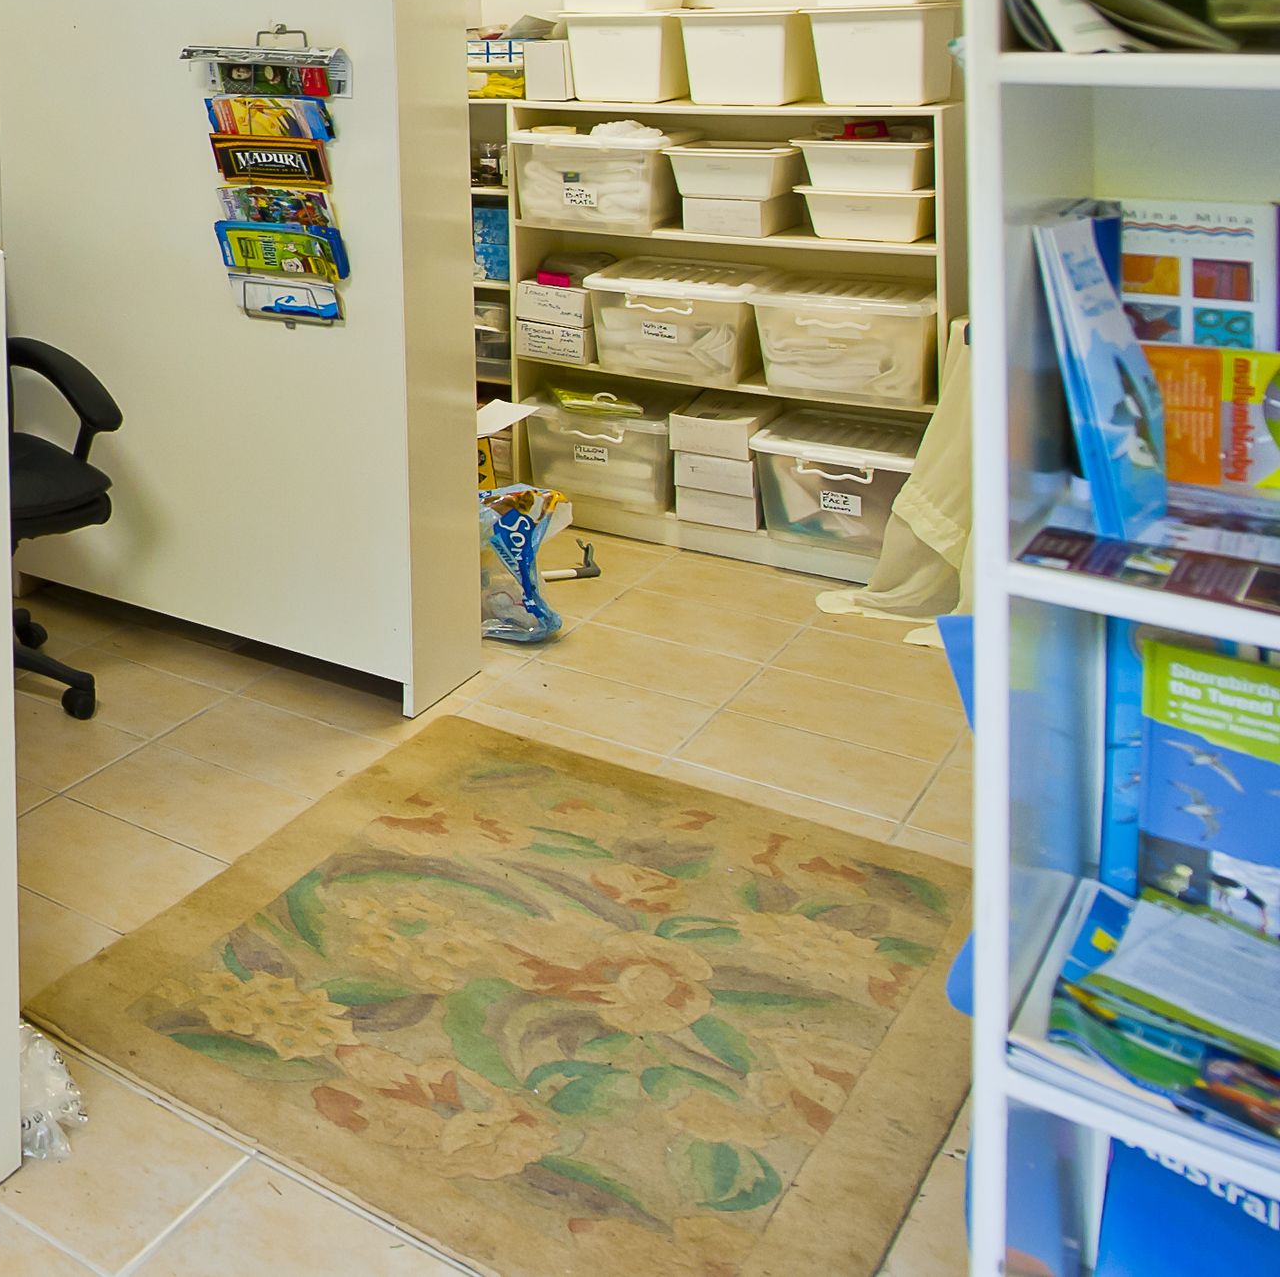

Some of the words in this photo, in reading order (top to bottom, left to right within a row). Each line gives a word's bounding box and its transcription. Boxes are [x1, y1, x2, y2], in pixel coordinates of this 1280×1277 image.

[236, 152, 308, 172] MADURA
[1196, 213, 1254, 225] Mina
[258, 235, 278, 267] Magic!
[521, 323, 555, 336] Personal
[1233, 357, 1256, 483] mullumbimby
[823, 497, 850, 505] FACE
[1208, 688, 1274, 716] Tweed
